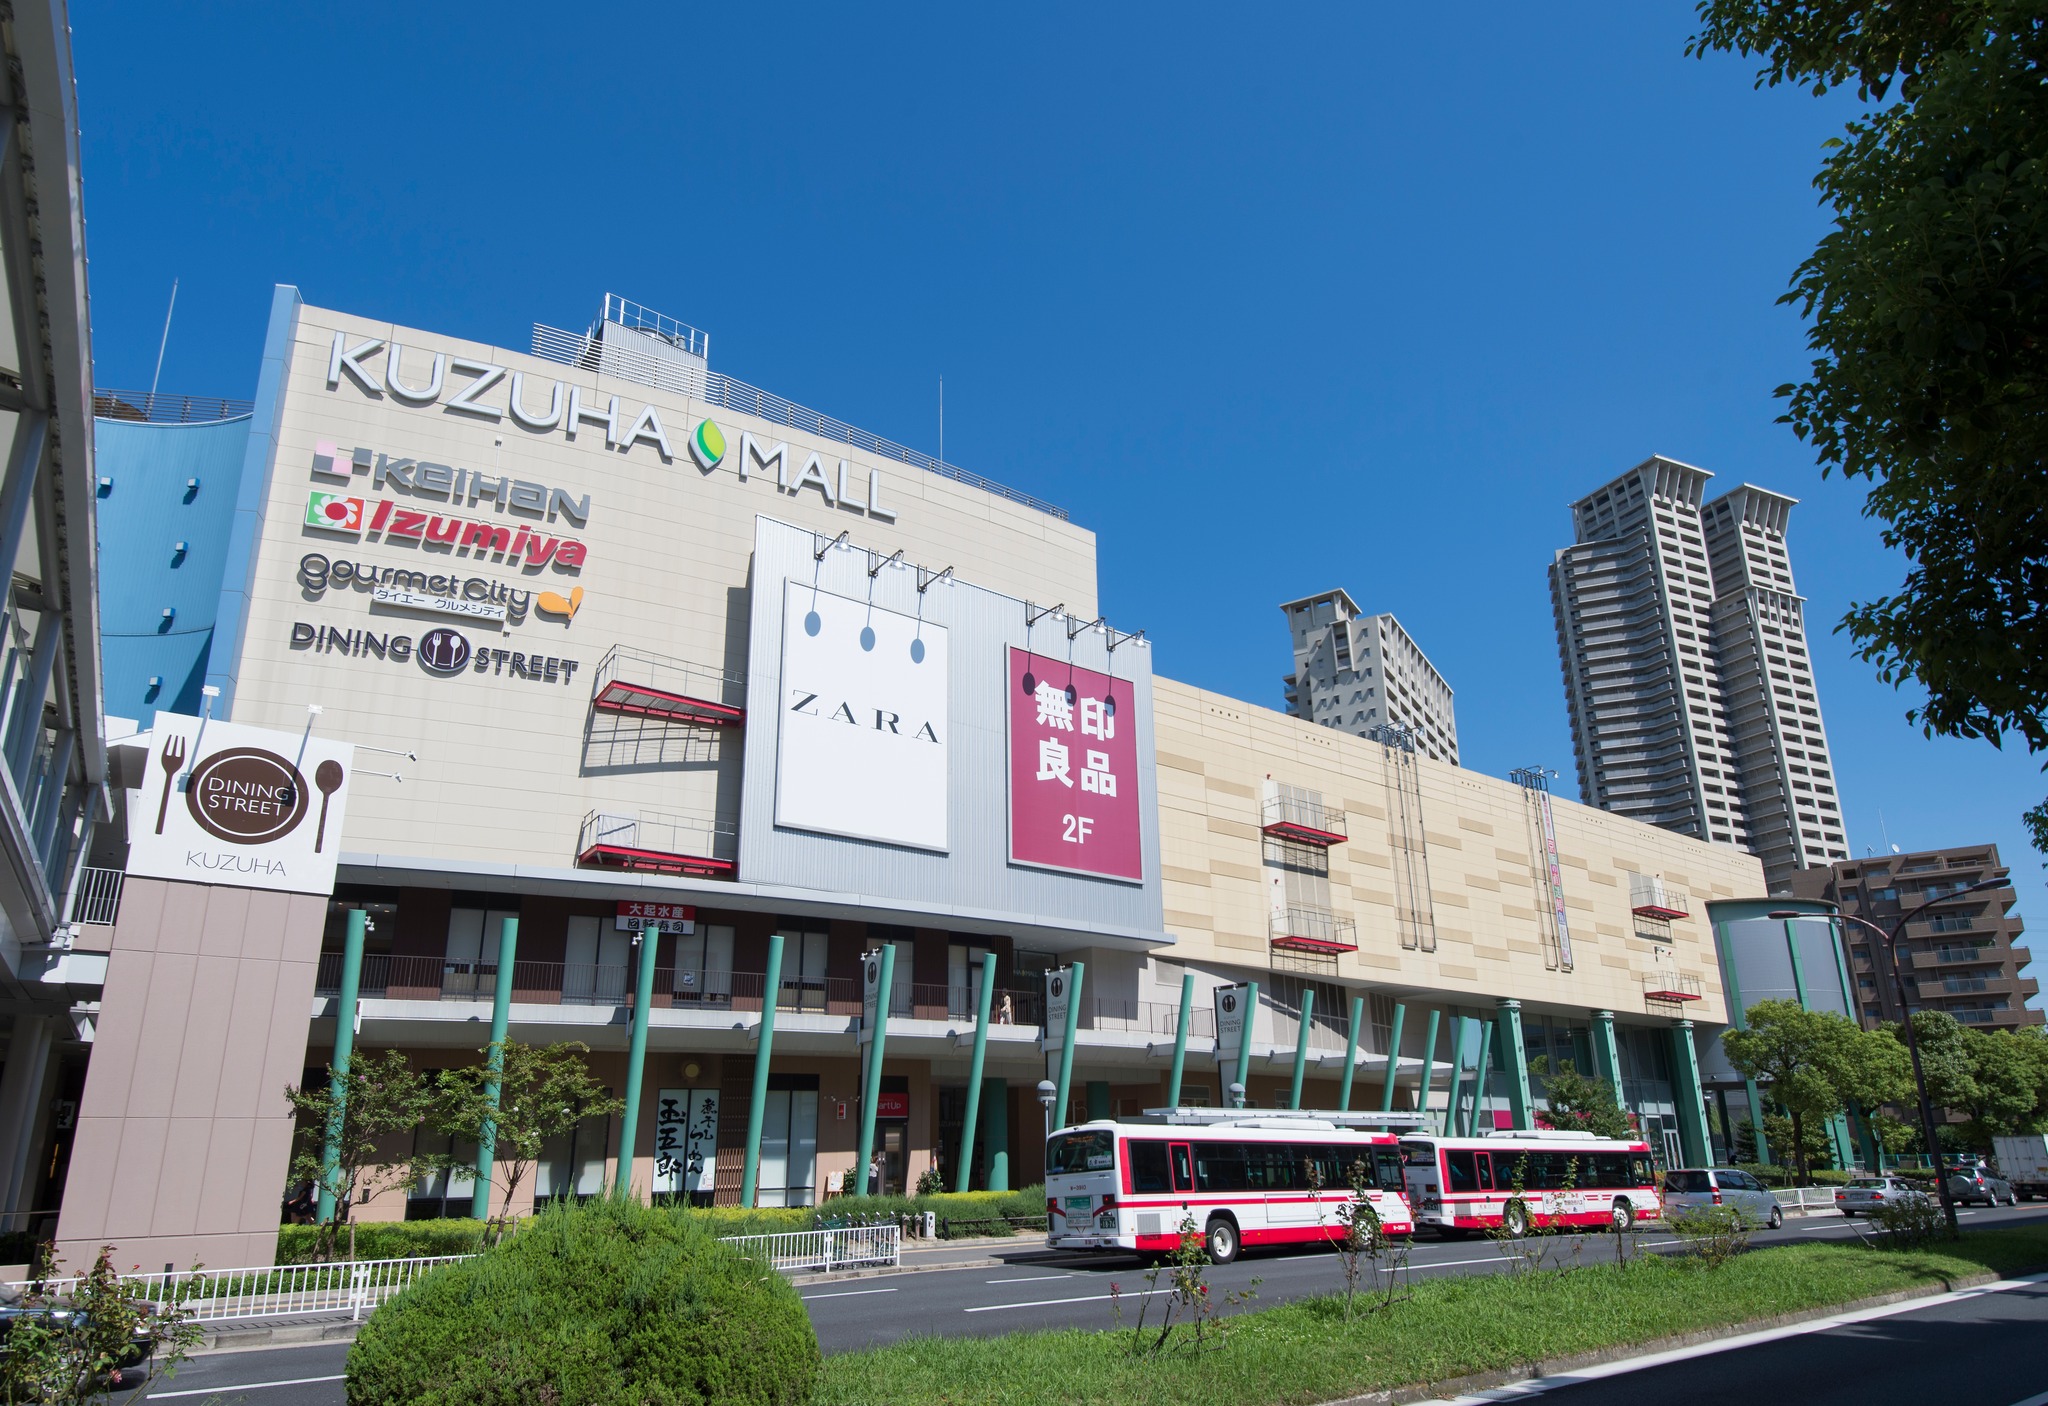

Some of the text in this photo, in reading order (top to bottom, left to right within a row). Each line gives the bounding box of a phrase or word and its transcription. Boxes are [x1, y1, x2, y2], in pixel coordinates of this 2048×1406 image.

[327, 330, 898, 519] KUZUHA MALL
[369, 499, 588, 567] Izumiya
[300, 553, 531, 617] gourmet City
[376, 589, 505, 618] ダイエー グルメシティ
[291, 622, 579, 679] DINING STREET
[790, 689, 942, 744] ZARA
[1034, 680, 1116, 741] 無印
[1036, 737, 1117, 797] 良品
[208, 777, 290, 800] DINING
[208, 794, 286, 816] STREET
[1062, 814, 1094, 844] 2F
[186, 851, 287, 877] KUZUHA
[628, 918, 684, 932] 回転寿司
[629, 903, 684, 918] 大起水産
[1048, 1004, 1066, 1013] DINING
[1048, 1012, 1066, 1021] STREET
[1220, 1019, 1241, 1027] DINING
[878, 1101, 901, 1110] artUp
[656, 1098, 686, 1181] 玉五郎
